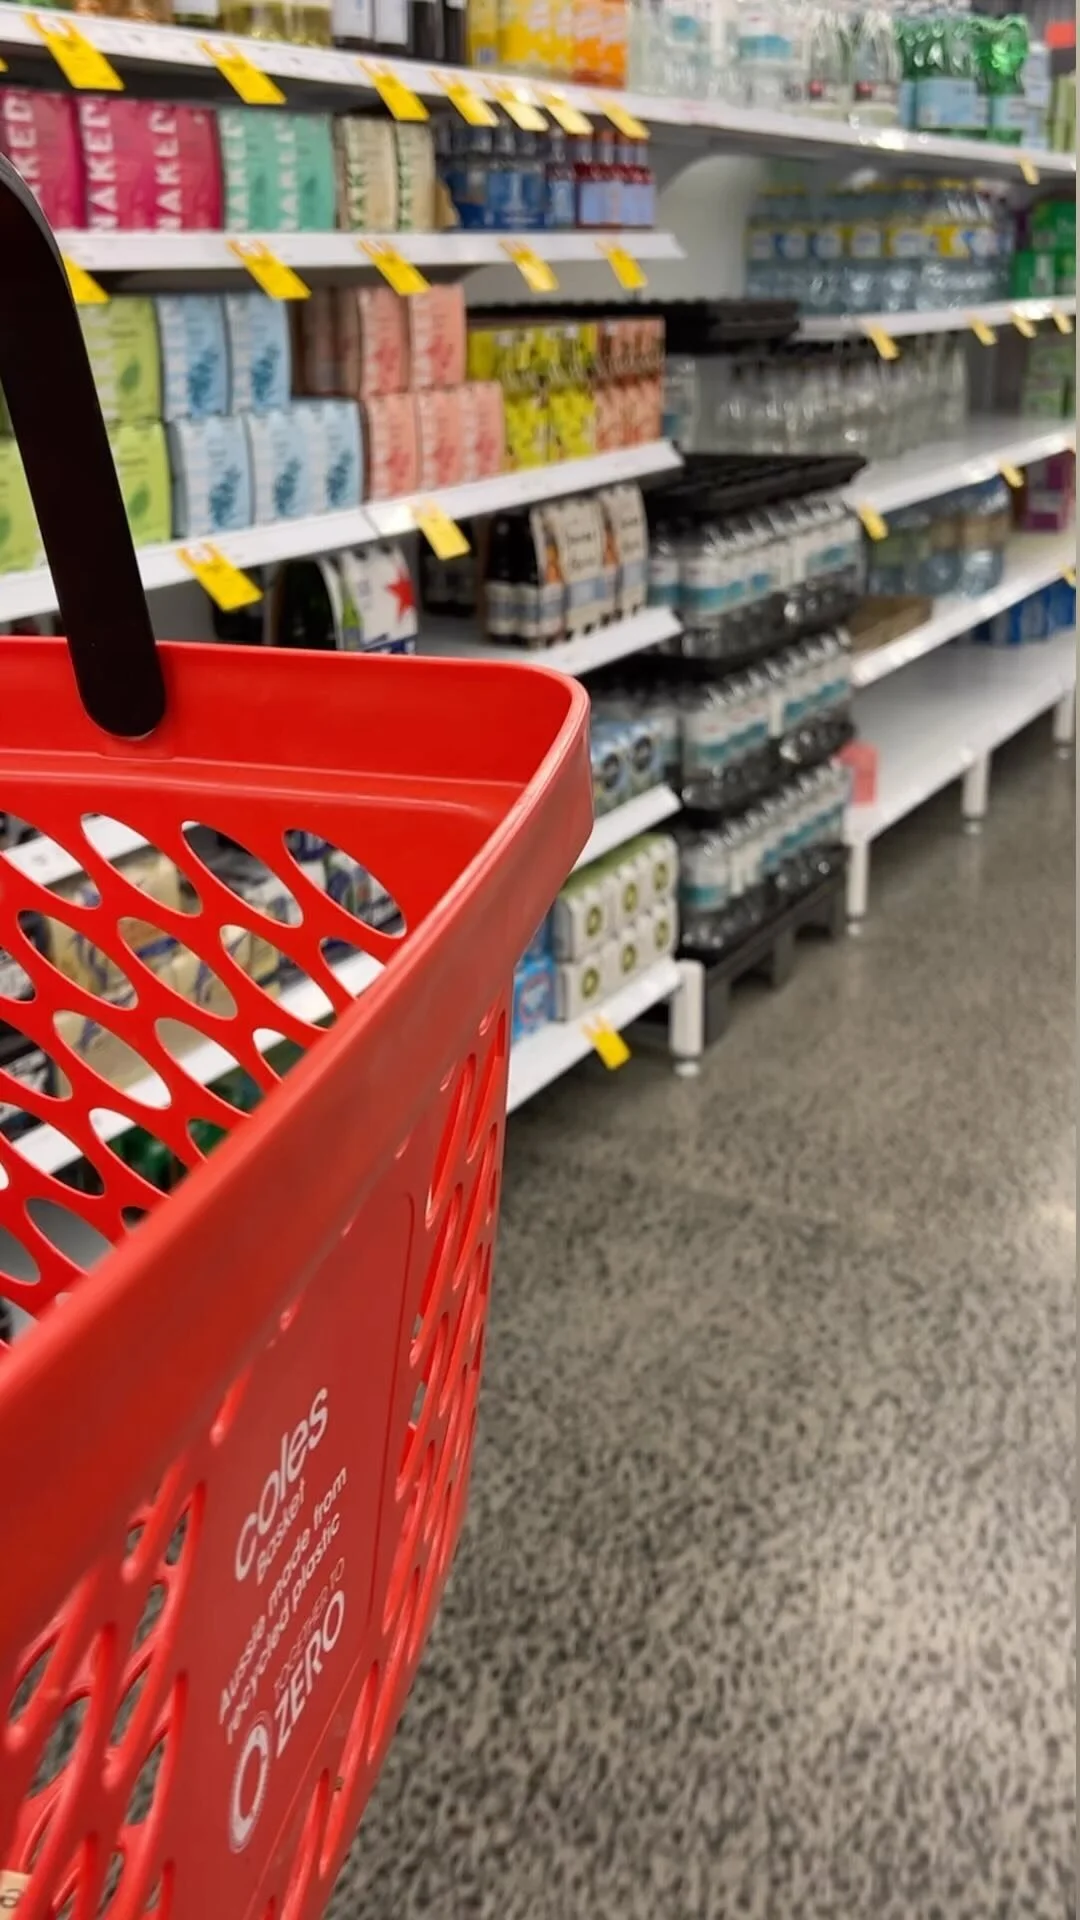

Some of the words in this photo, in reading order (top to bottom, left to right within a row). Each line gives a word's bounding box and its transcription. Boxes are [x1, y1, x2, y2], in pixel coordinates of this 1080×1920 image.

[235, 1387, 328, 1582] coles
[256, 1477, 305, 1585] Basket
[269, 1527, 311, 1617] made
[313, 1467, 347, 1531] from
[227, 1596, 291, 1745] recycled
[291, 1512, 341, 1614] plastic
[274, 1590, 345, 1759] ZERO
